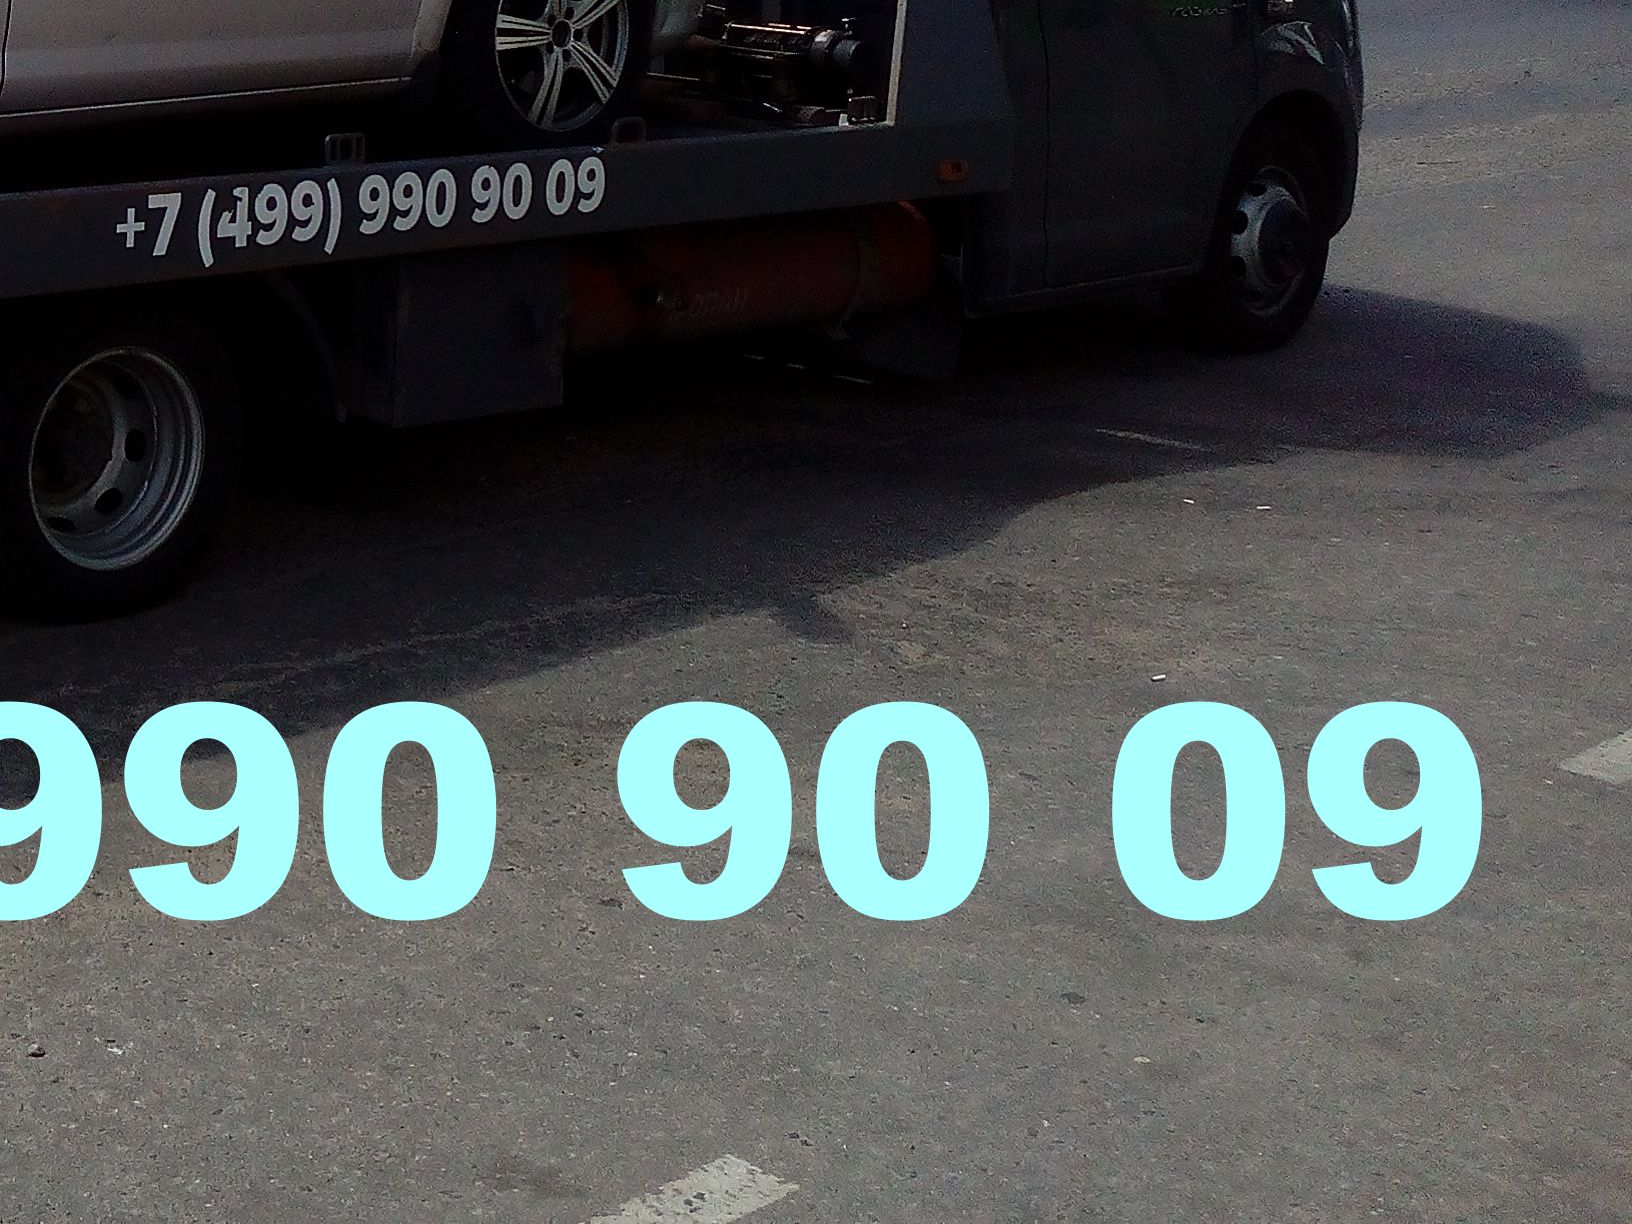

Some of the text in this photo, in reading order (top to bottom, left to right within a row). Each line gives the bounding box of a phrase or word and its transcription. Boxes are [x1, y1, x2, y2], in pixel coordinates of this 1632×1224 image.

[116, 156, 605, 268] +7 (499) 990 90 09
